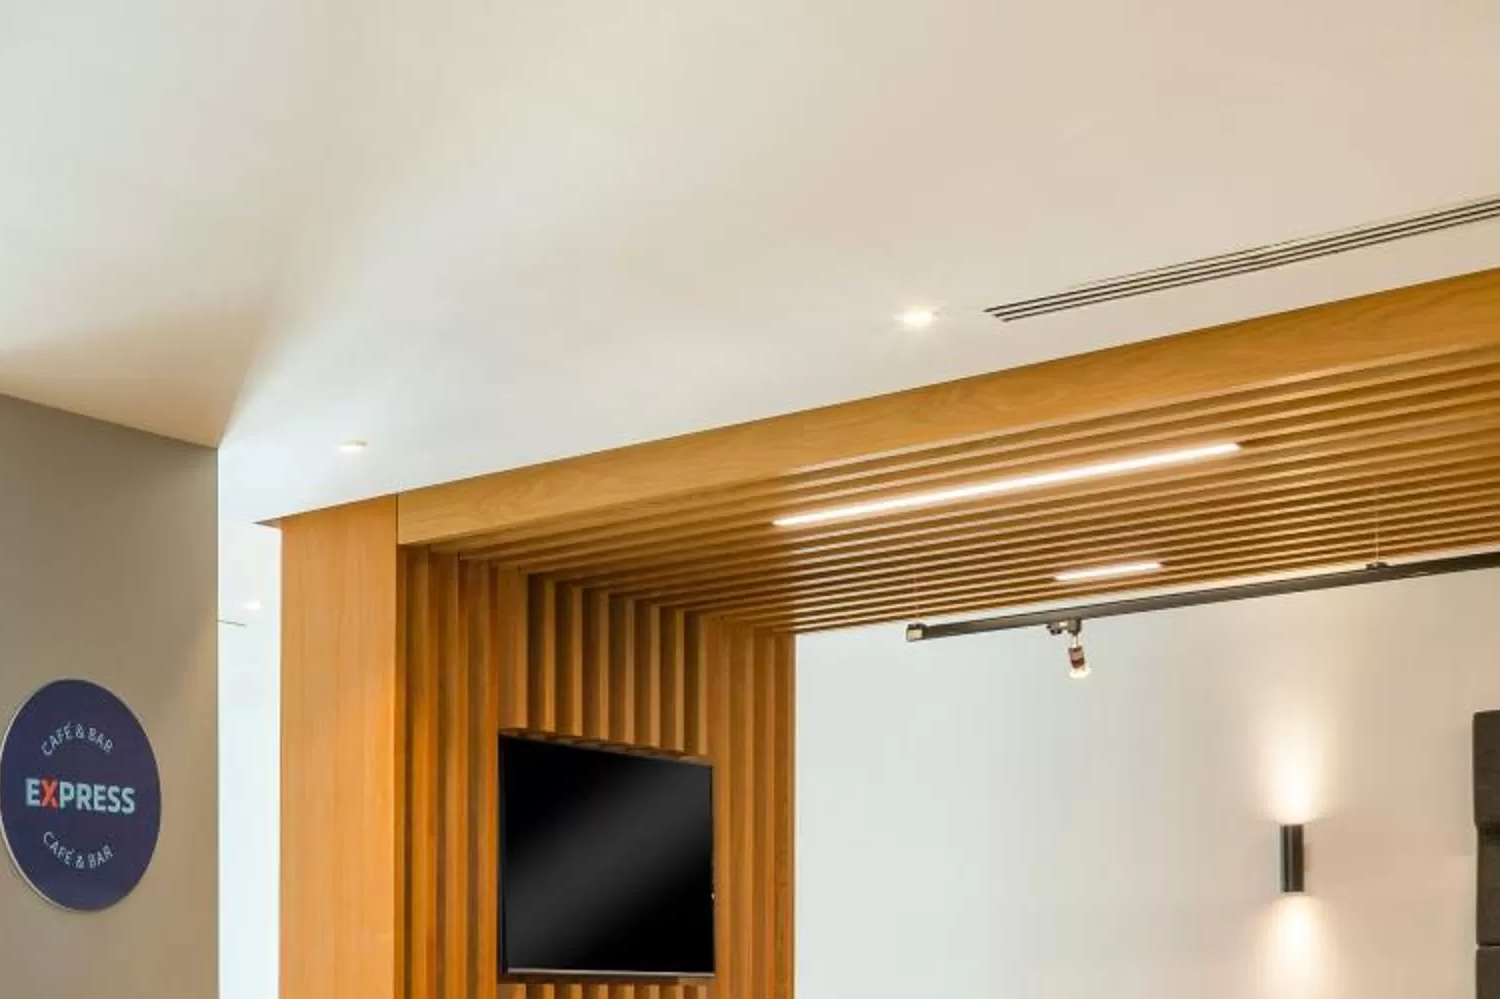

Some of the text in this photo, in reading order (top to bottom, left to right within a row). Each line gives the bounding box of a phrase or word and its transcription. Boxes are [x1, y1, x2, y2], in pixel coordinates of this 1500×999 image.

[75, 723, 85, 739] &
[88, 727, 113, 753] BAR
[25, 777, 136, 814] EXPRESS
[75, 855, 85, 869] &
[87, 844, 113, 869] BAR
